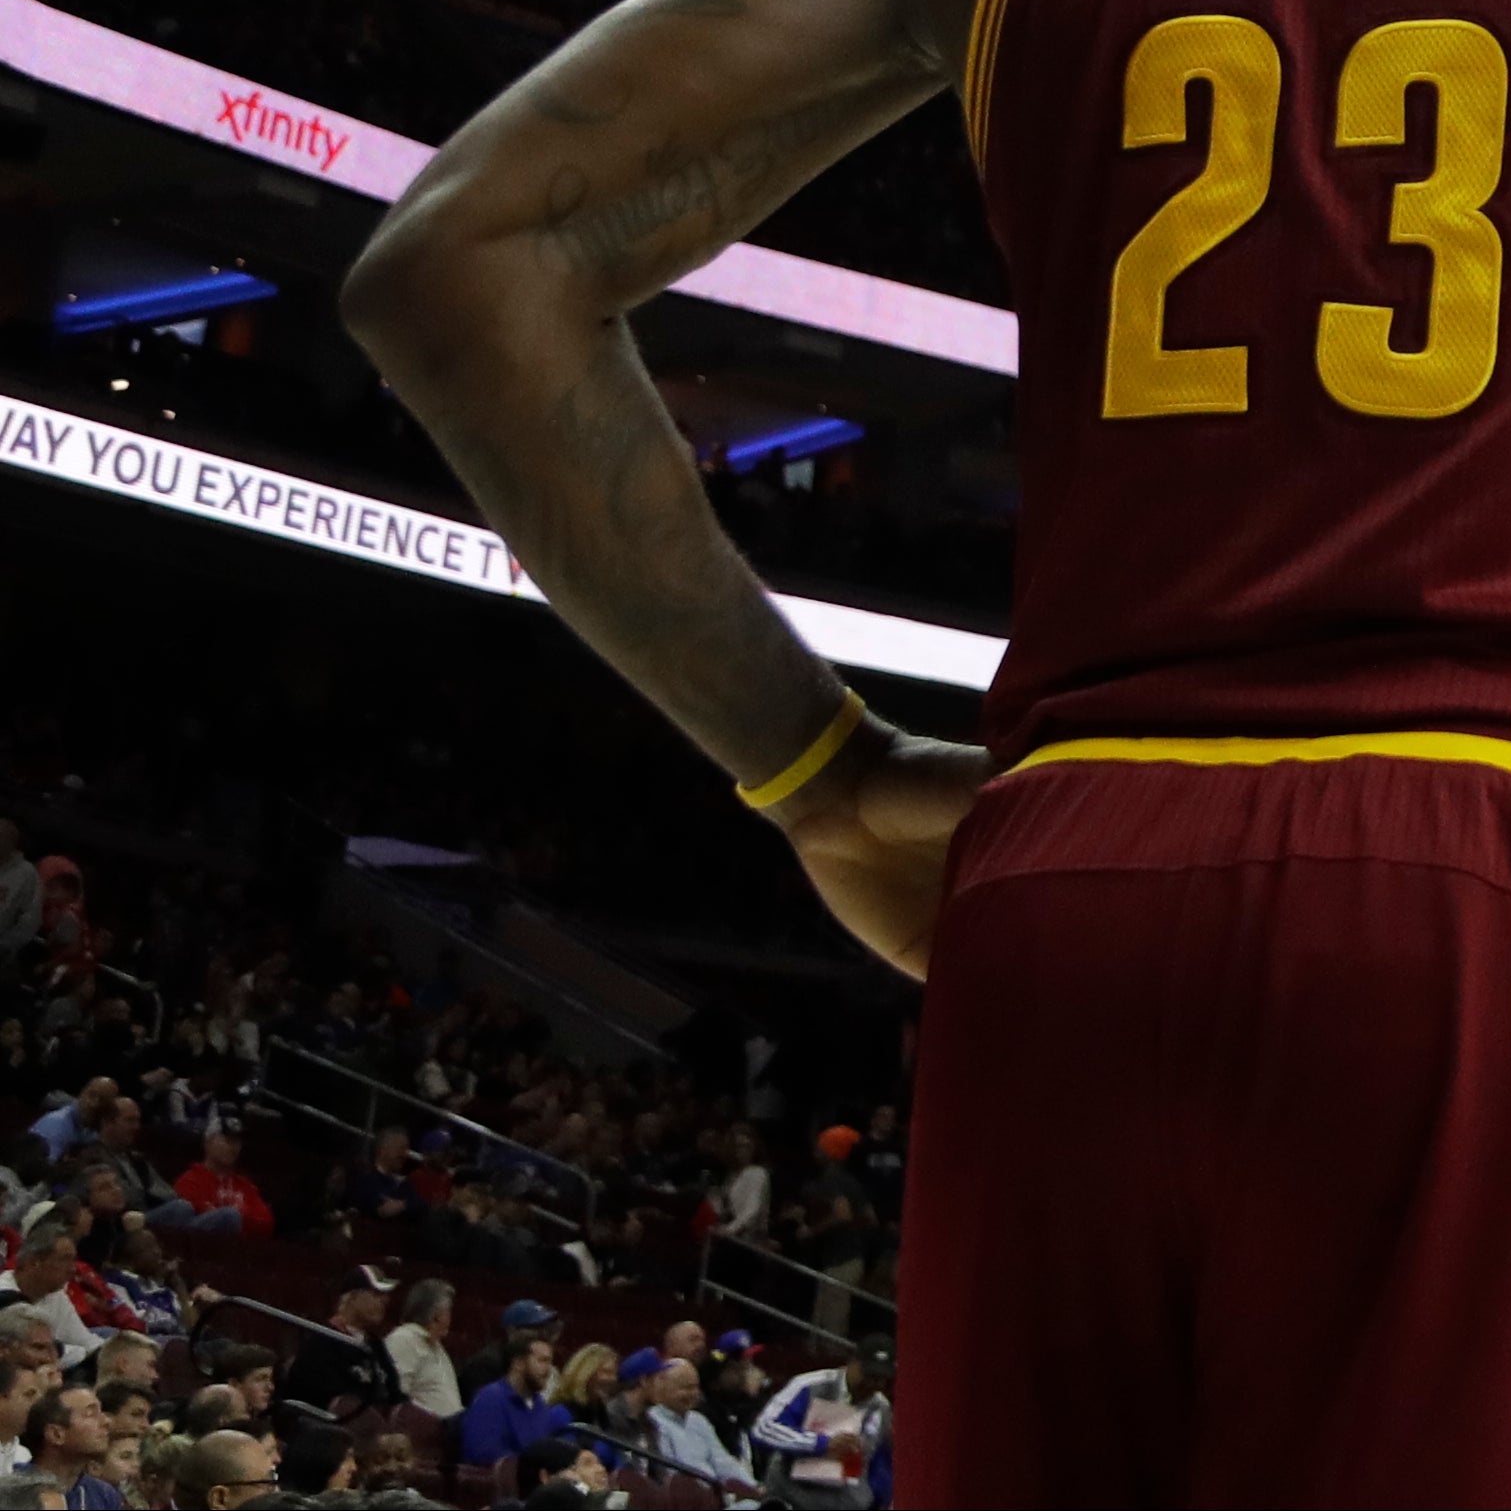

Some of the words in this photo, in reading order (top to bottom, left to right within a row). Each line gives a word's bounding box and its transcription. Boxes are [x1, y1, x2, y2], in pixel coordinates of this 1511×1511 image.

[216, 90, 350, 173] xfinity
[1102, 14, 1508, 420] 23
[0, 408, 74, 464] AY
[87, 430, 182, 495] YOU
[194, 462, 468, 572] EXPERIENCE
